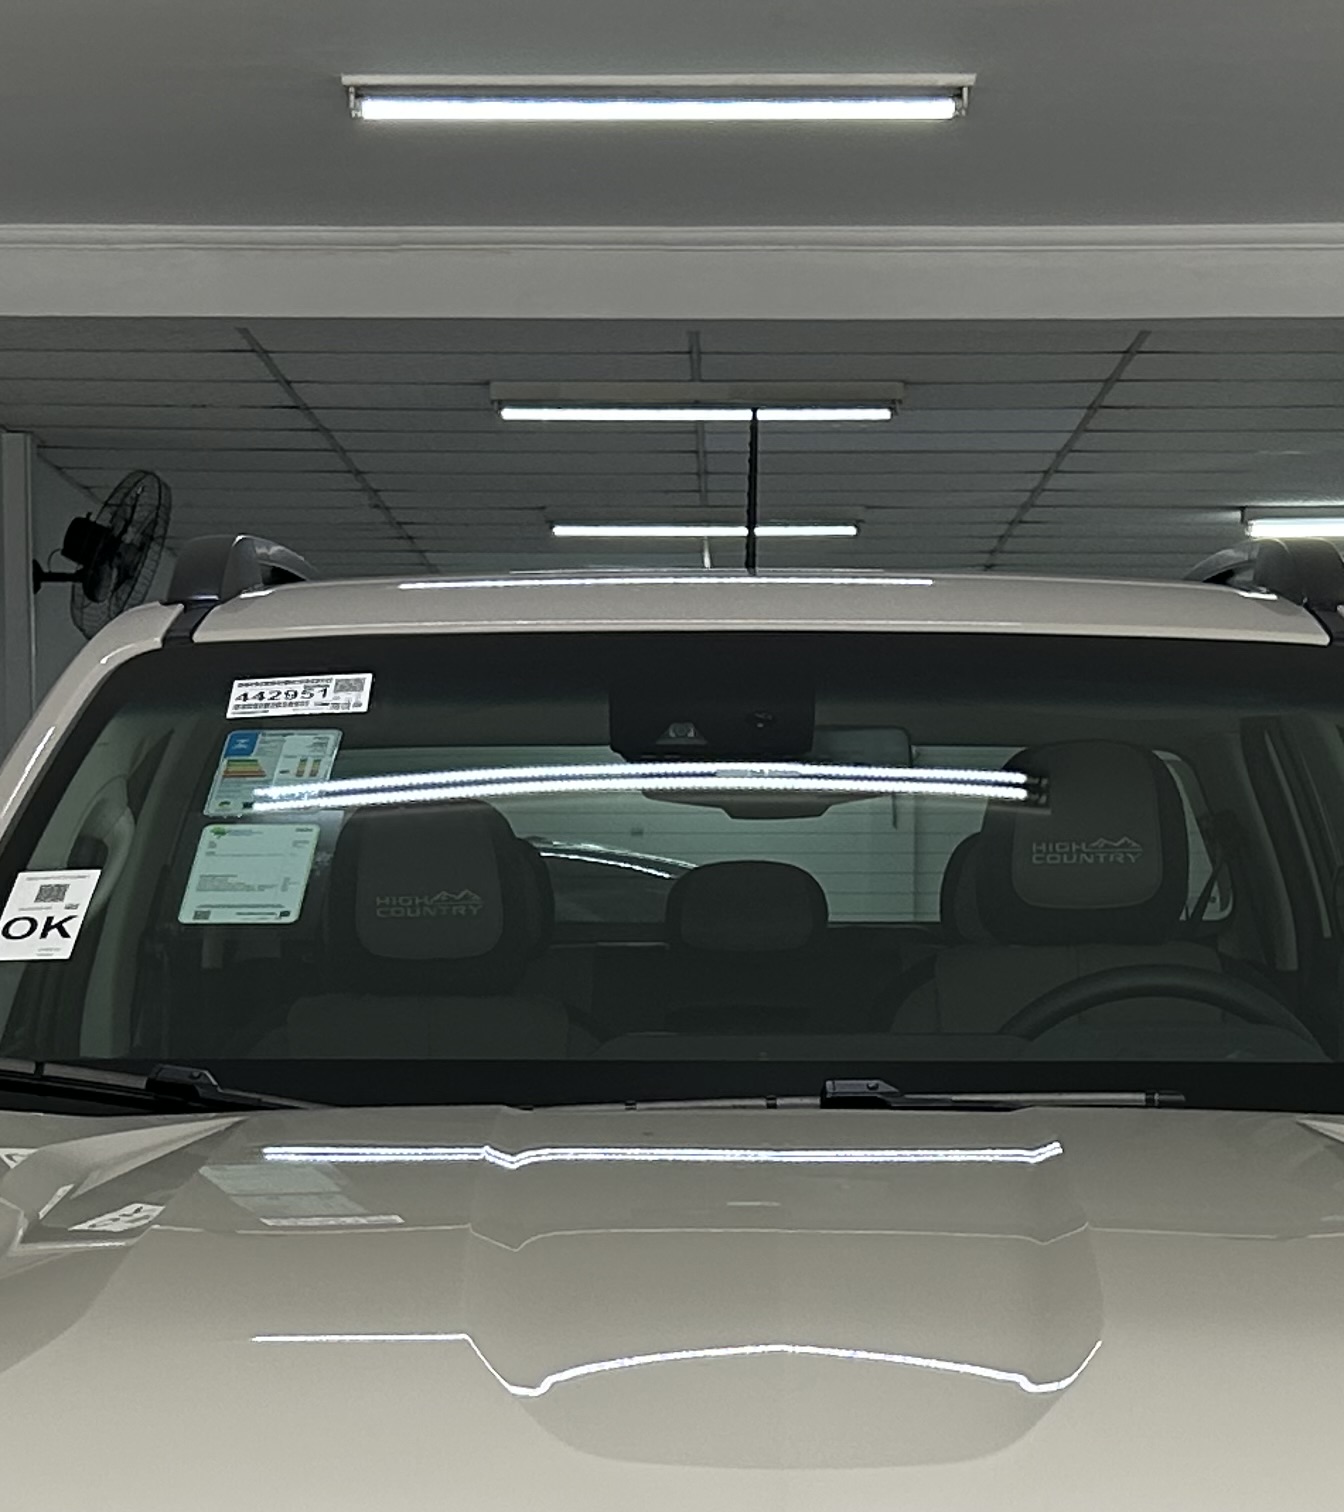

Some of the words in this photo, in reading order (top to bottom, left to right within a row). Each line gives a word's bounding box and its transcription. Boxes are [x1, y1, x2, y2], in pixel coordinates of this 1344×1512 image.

[1032, 842, 1086, 853] HIGH
[1032, 853, 1143, 864] COUNTRY
[376, 896, 435, 906] HIGH
[376, 904, 484, 918] COUNTRY
[1, 915, 79, 940] OK
